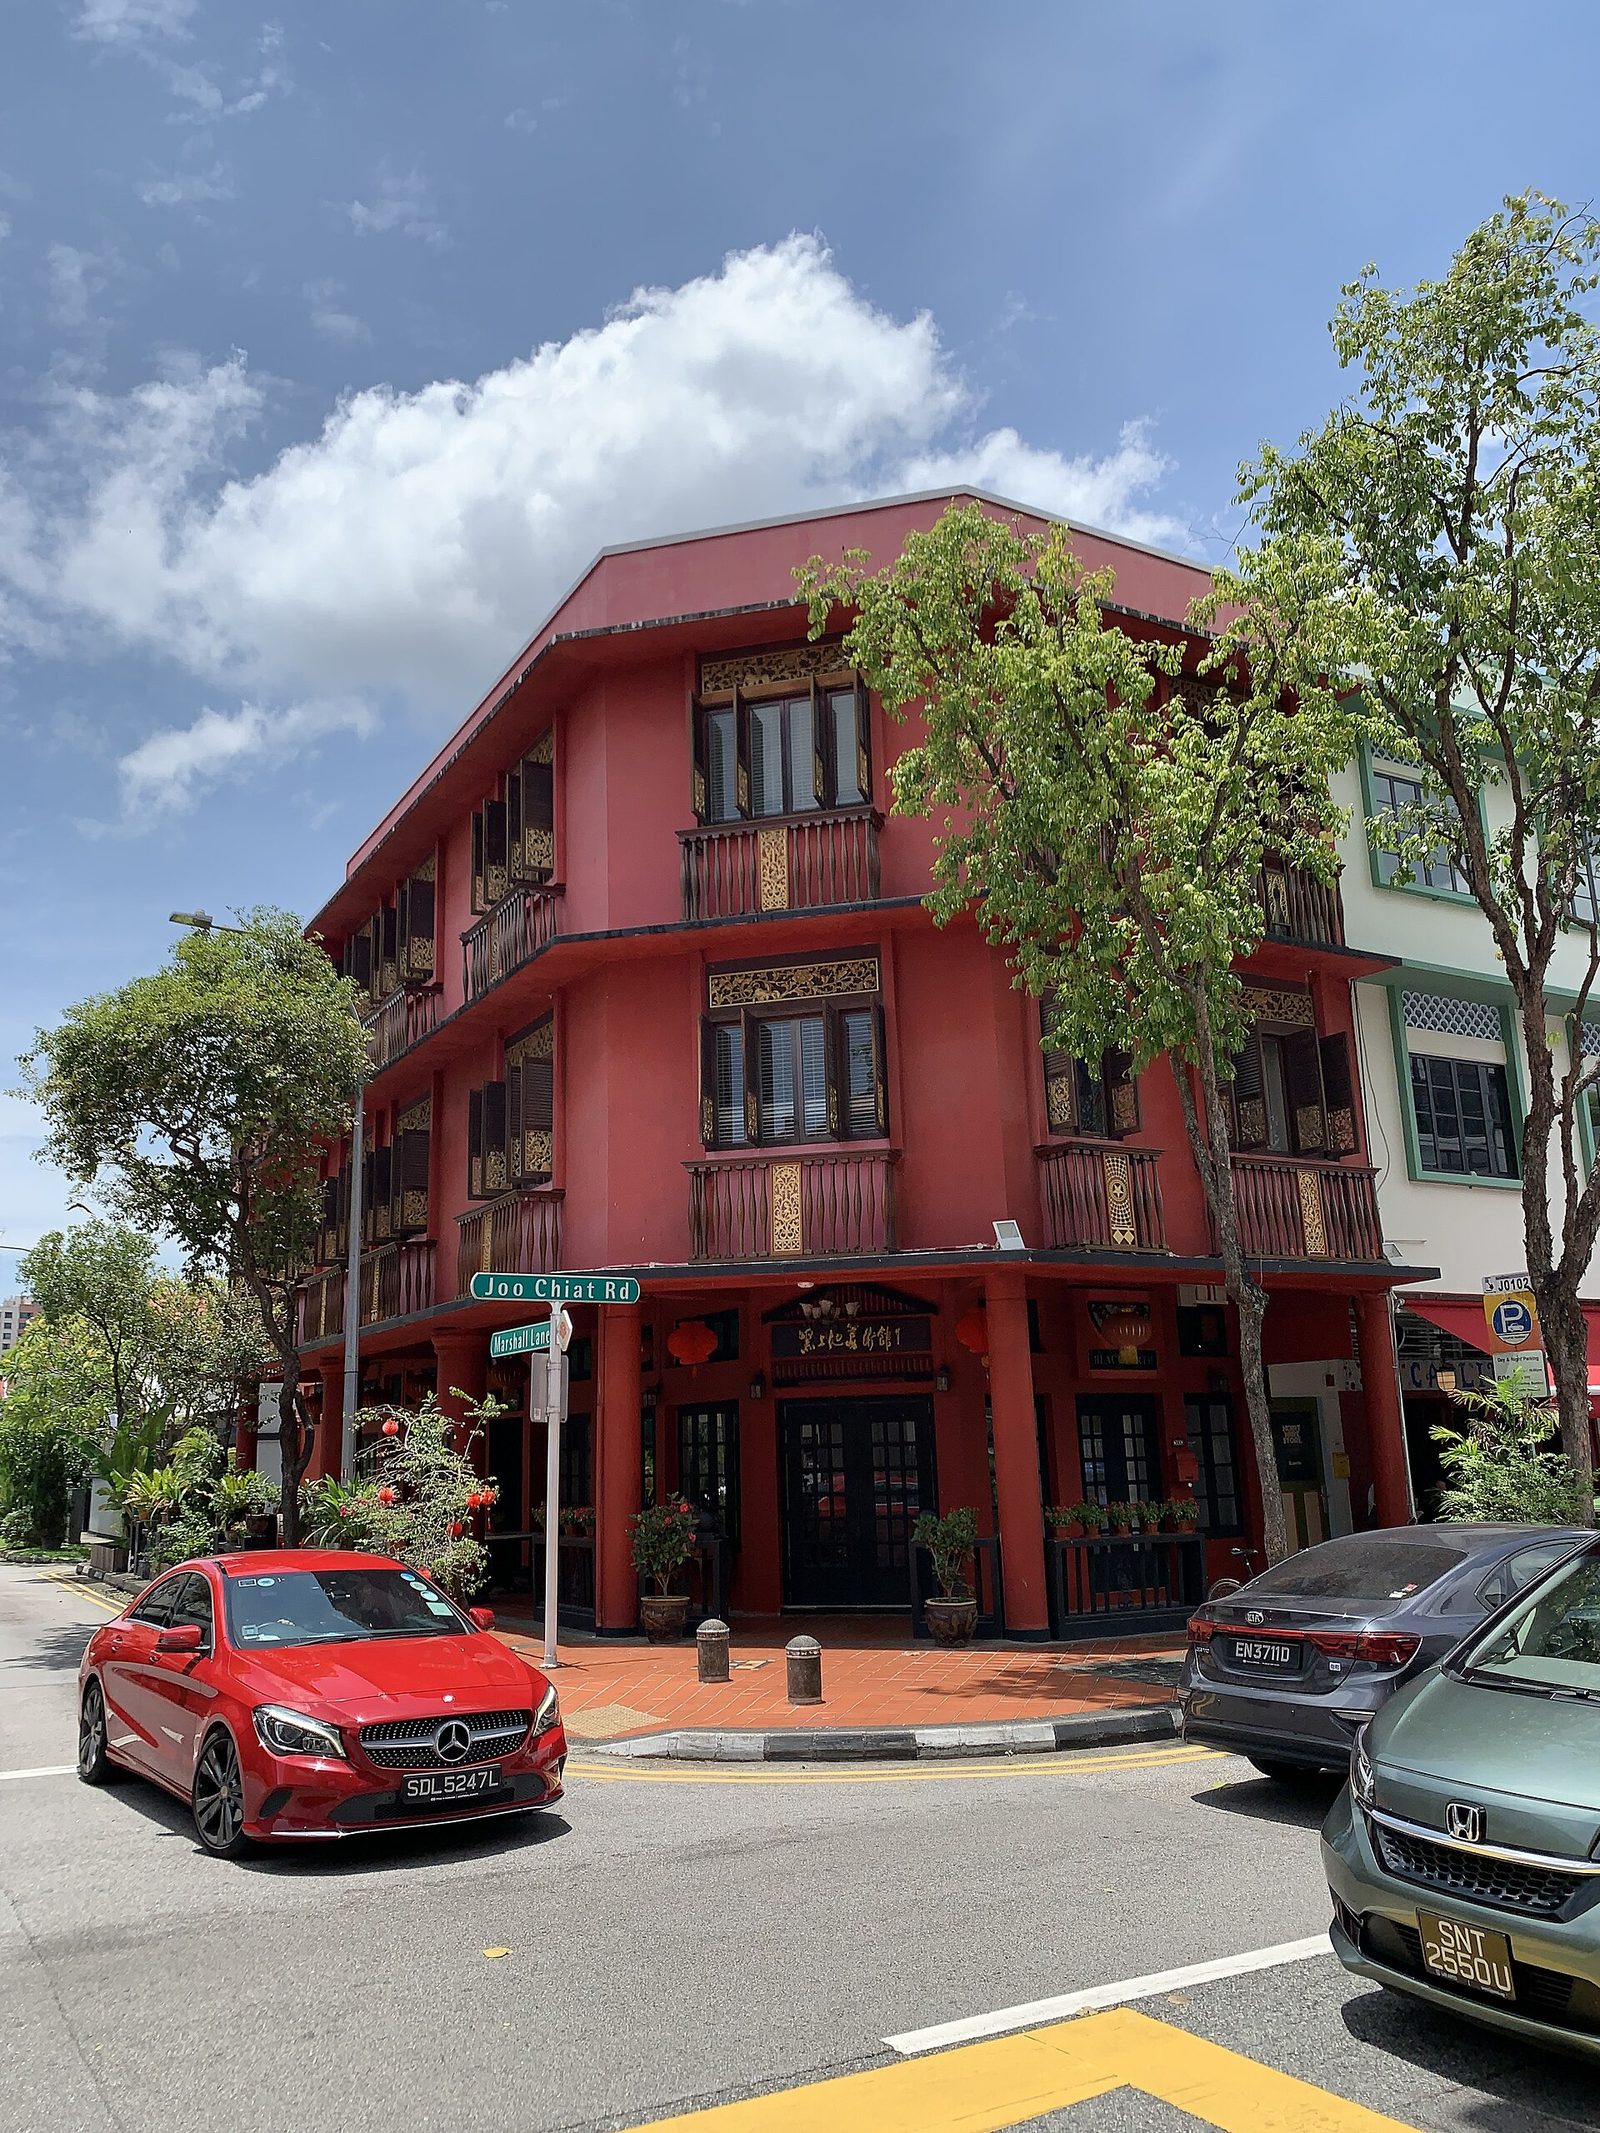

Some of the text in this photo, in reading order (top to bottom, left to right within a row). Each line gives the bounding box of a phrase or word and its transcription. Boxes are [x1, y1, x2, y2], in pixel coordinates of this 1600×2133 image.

[485, 1277, 629, 1300] Joo Chiat Rd
[1498, 1277, 1529, 1292] J0102
[1500, 1304, 1523, 1333] P
[494, 1329, 550, 1353] Marshall Lane
[1235, 1641, 1290, 1662] EN3711D
[407, 1770, 499, 1797] SDL5247L
[1438, 1920, 1485, 1957] SNT
[1426, 1941, 1511, 1992] 2550U
